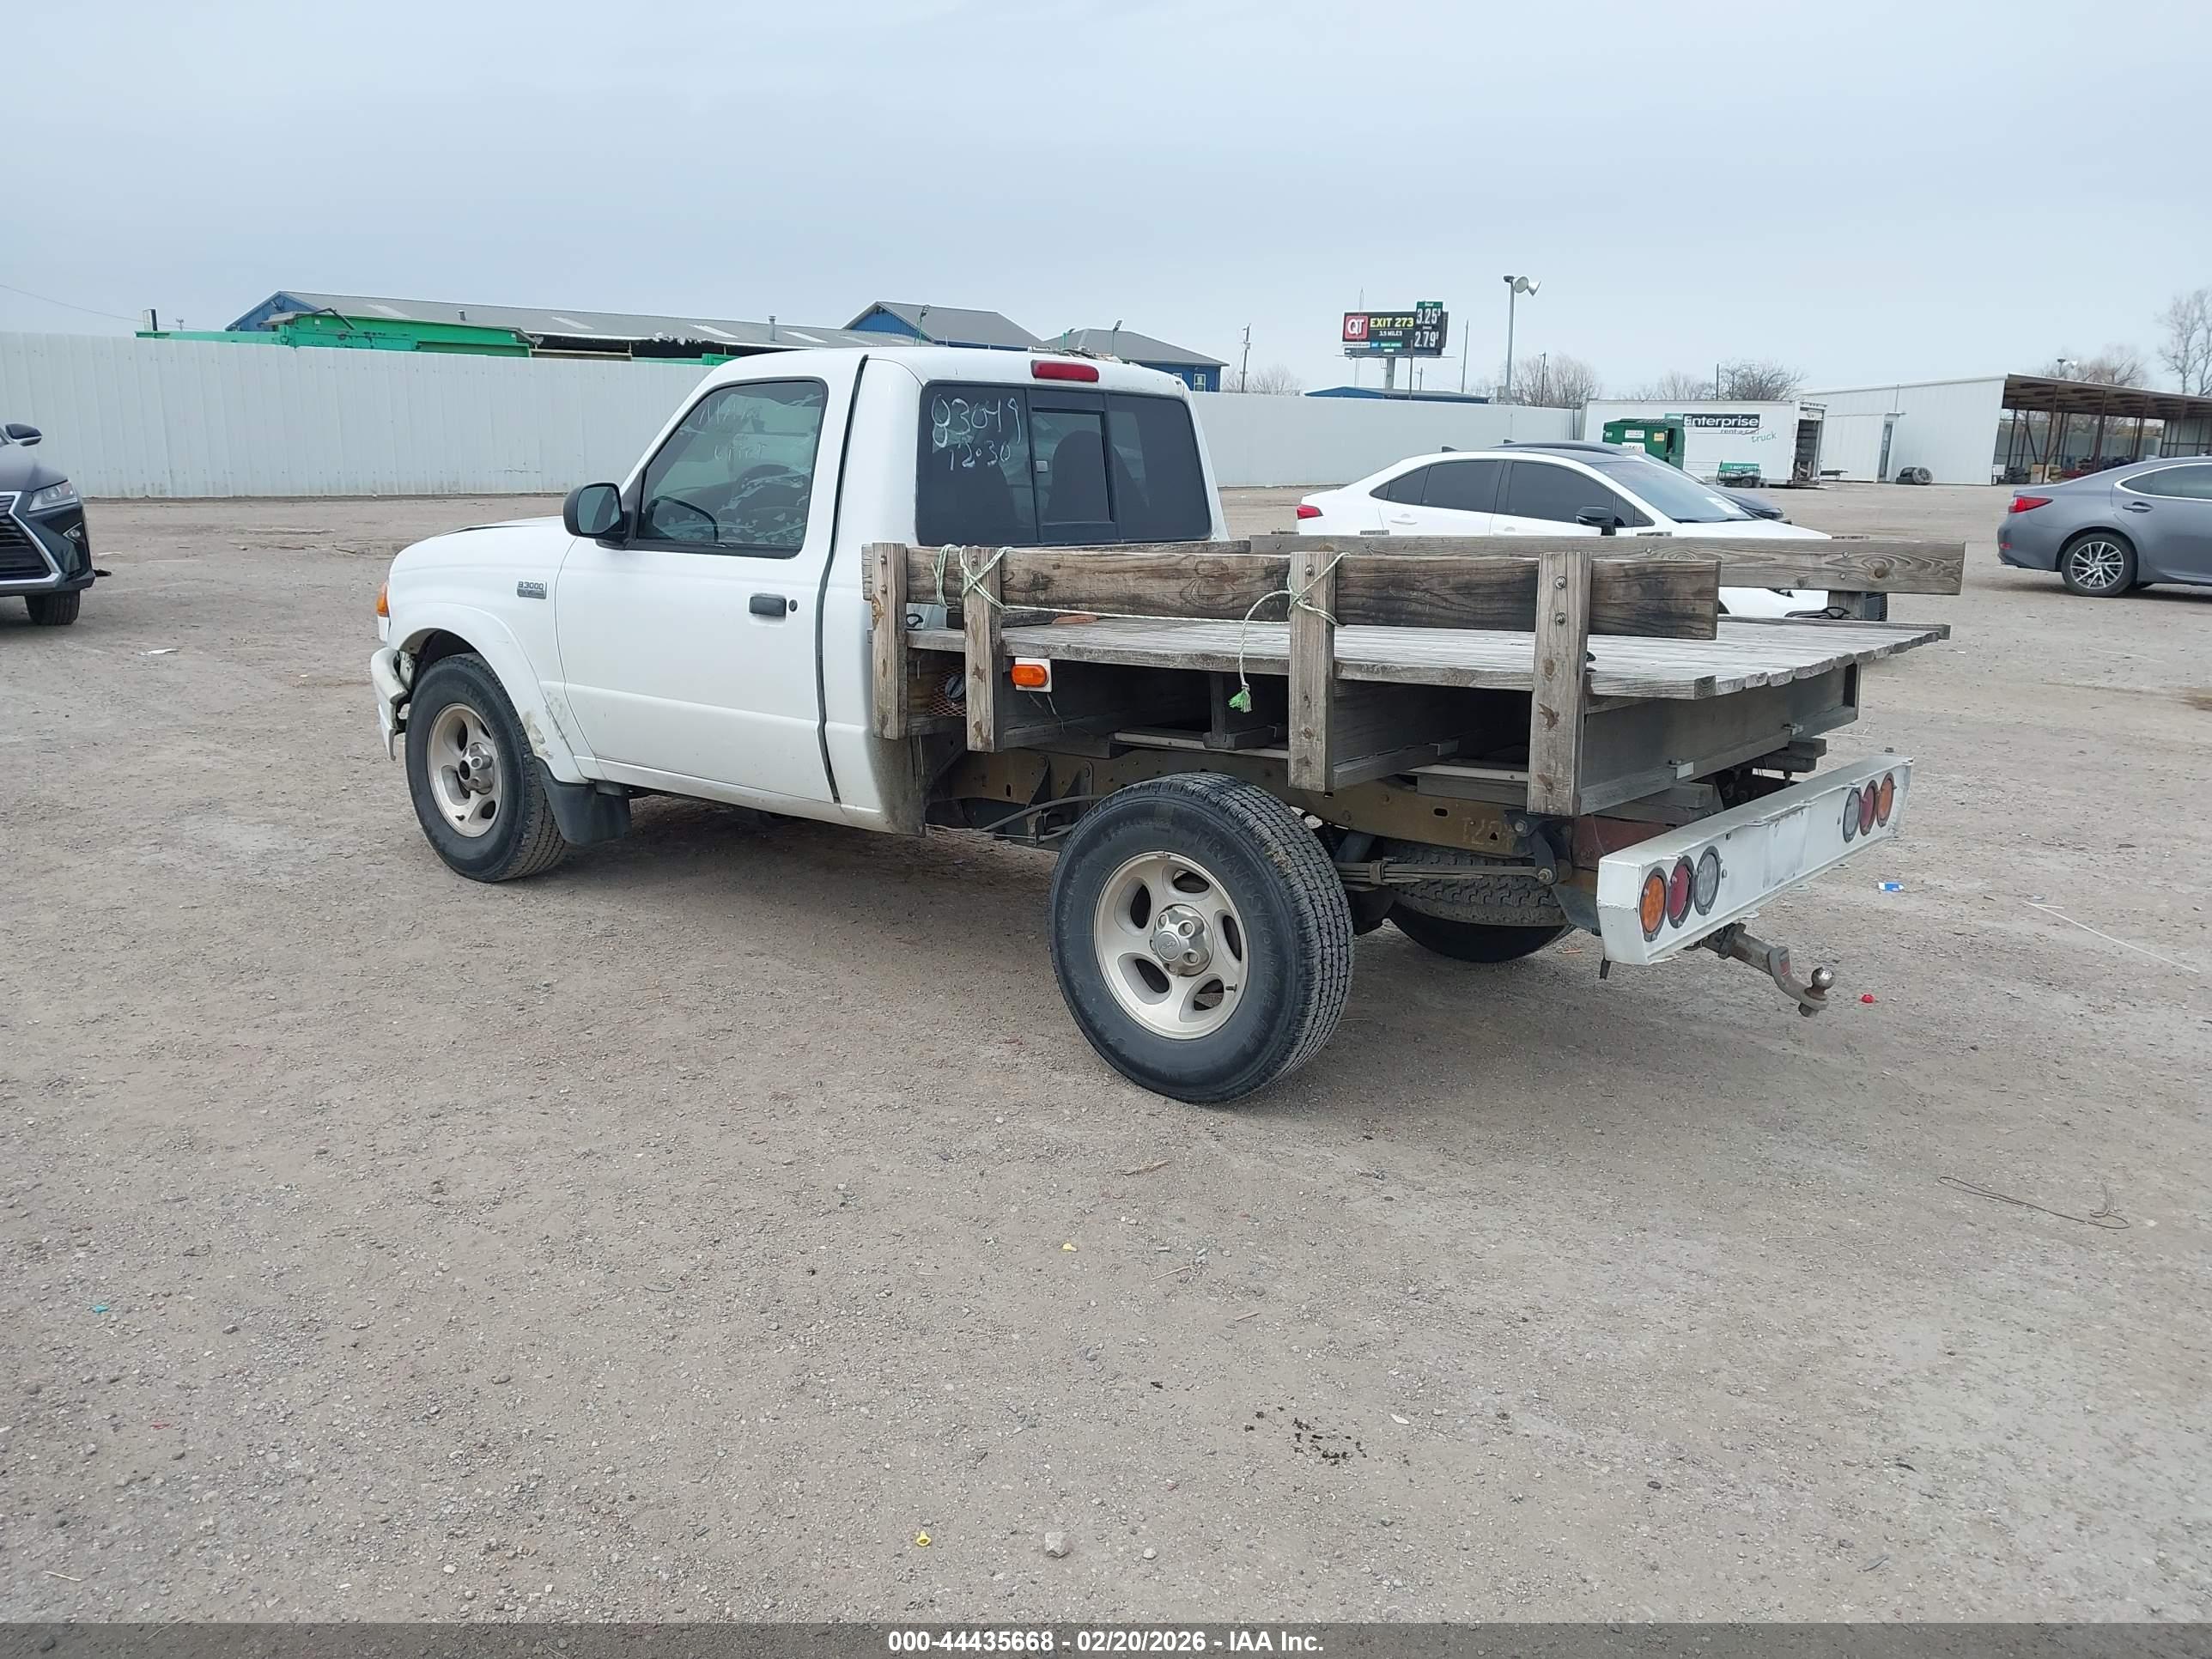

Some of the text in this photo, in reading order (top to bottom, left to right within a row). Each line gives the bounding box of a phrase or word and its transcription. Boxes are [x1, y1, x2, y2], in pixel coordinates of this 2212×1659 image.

[1346, 318, 1364, 335] QT
[1370, 317, 1414, 328] EXIT 273
[1683, 416, 1759, 428] Enterprise
[1751, 431, 1778, 443] truck
[518, 581, 544, 590] B3000
